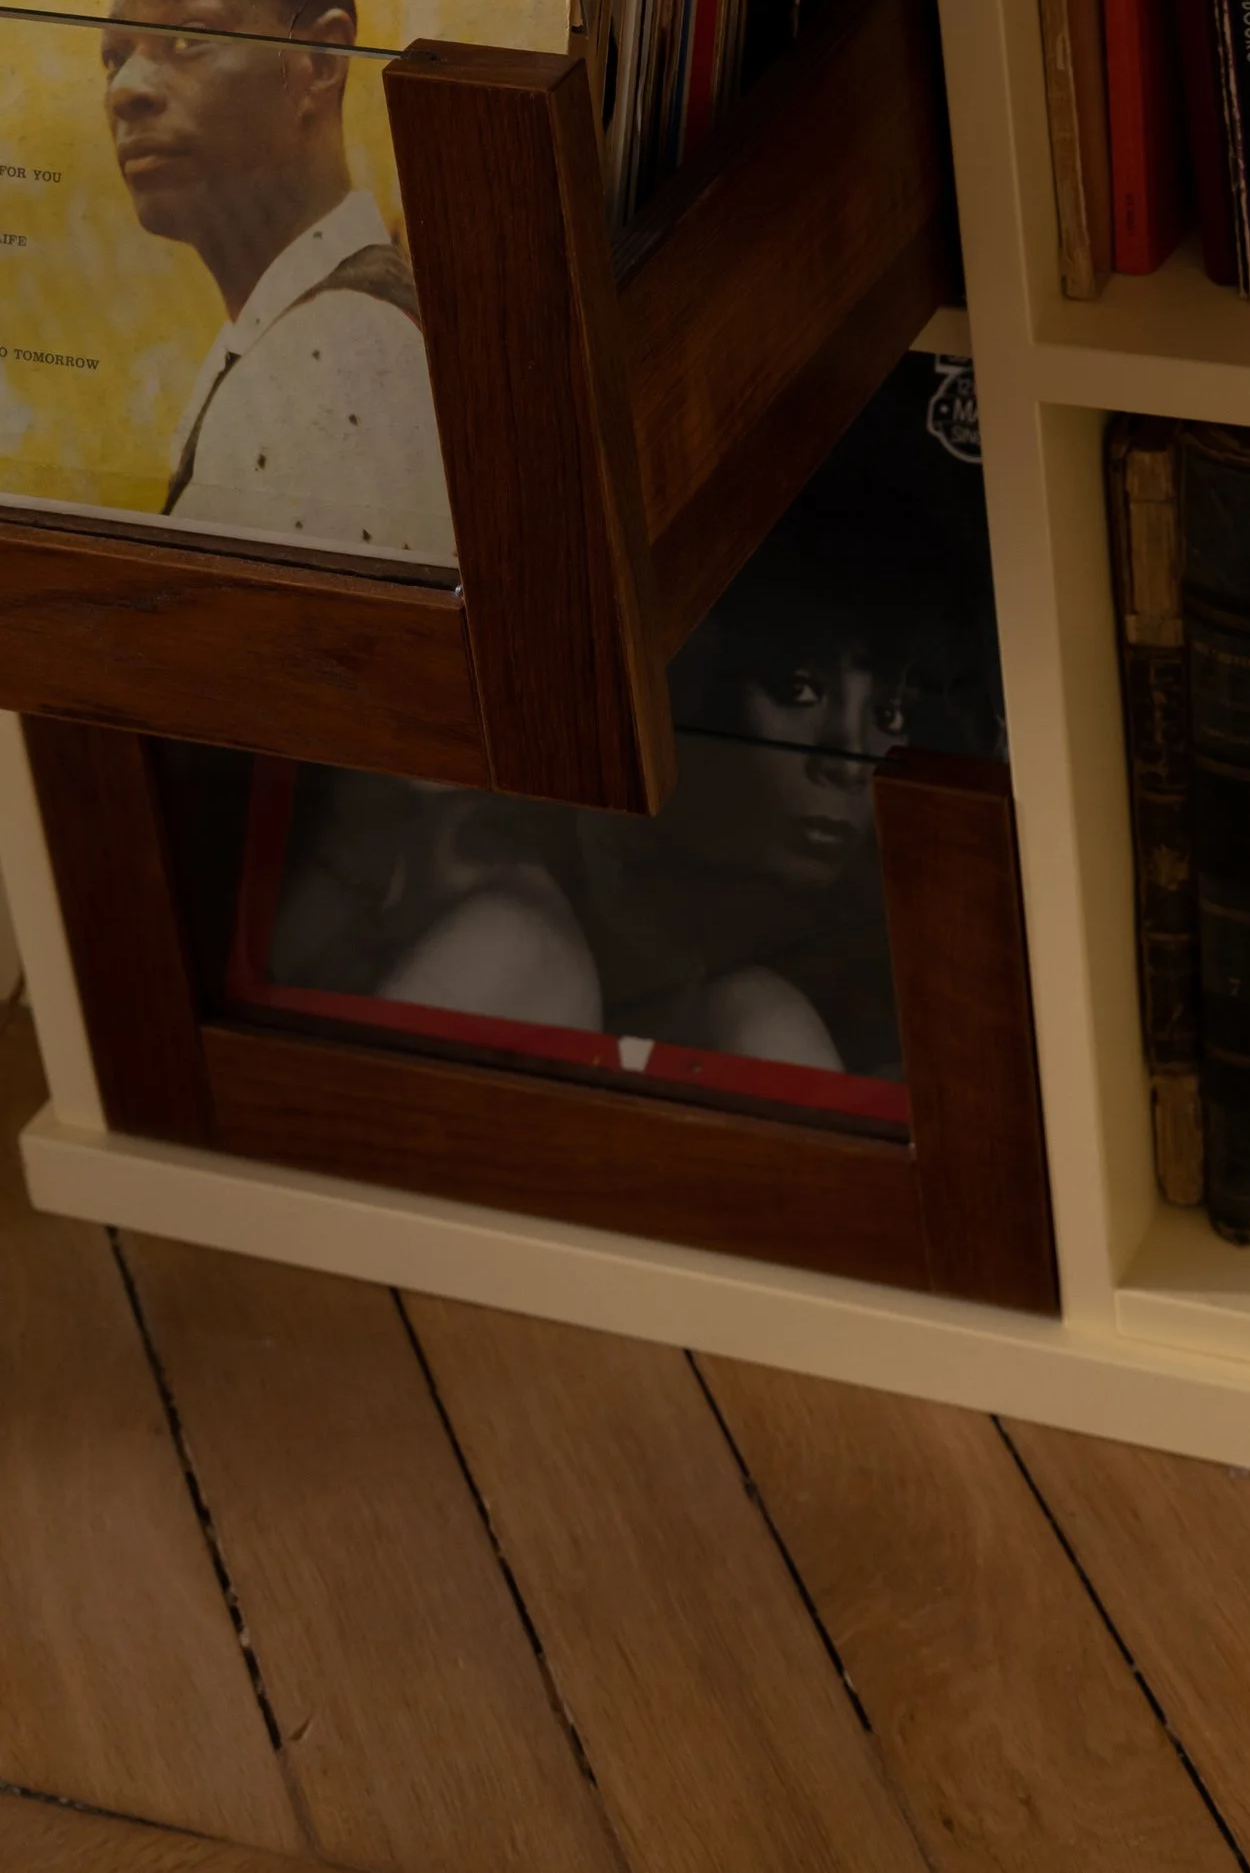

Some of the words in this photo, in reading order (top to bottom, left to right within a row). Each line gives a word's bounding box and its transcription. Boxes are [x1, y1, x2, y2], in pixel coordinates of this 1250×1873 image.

[33, 169, 62, 183] YOU
[0, 233, 27, 247] IFE
[13, 348, 100, 370] TOMORROW
